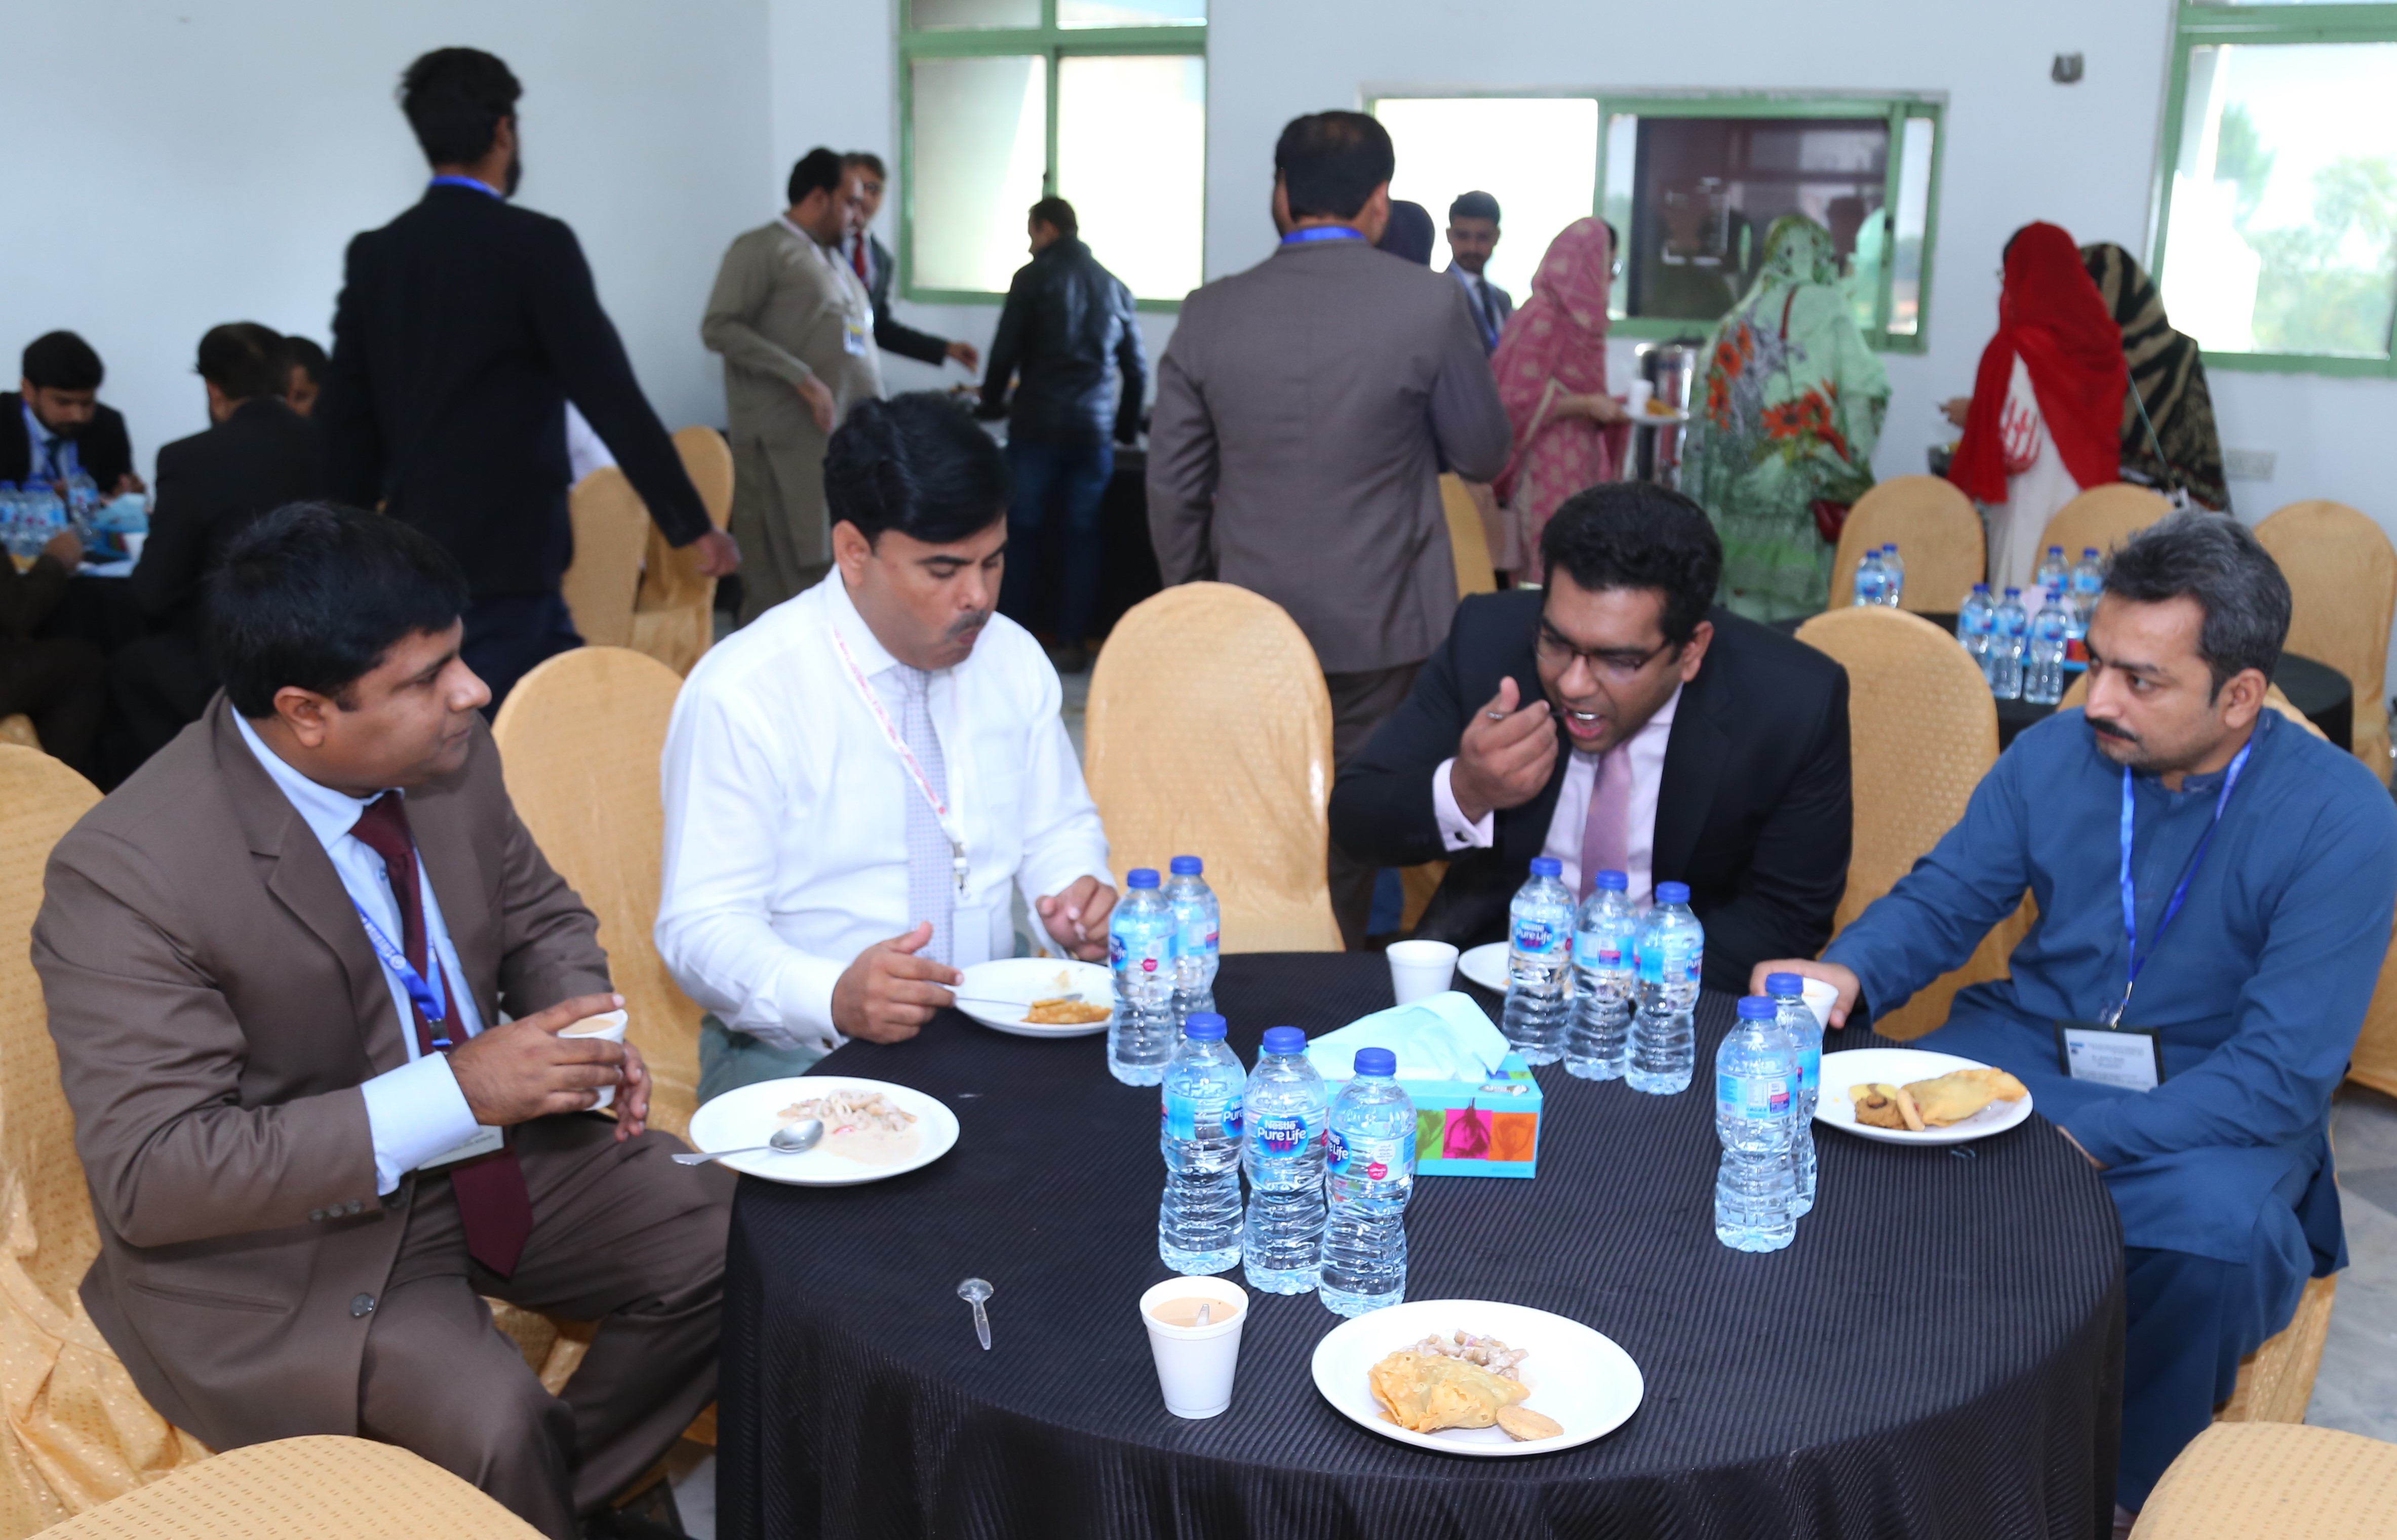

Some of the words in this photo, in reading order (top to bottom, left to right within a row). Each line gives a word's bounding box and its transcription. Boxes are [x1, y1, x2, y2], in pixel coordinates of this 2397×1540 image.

[1685, 958, 1702, 969] Pur
[1258, 1127, 1285, 1141] Pure
[1286, 1129, 1307, 1145] Life
[1333, 1143, 1349, 1161] Life
